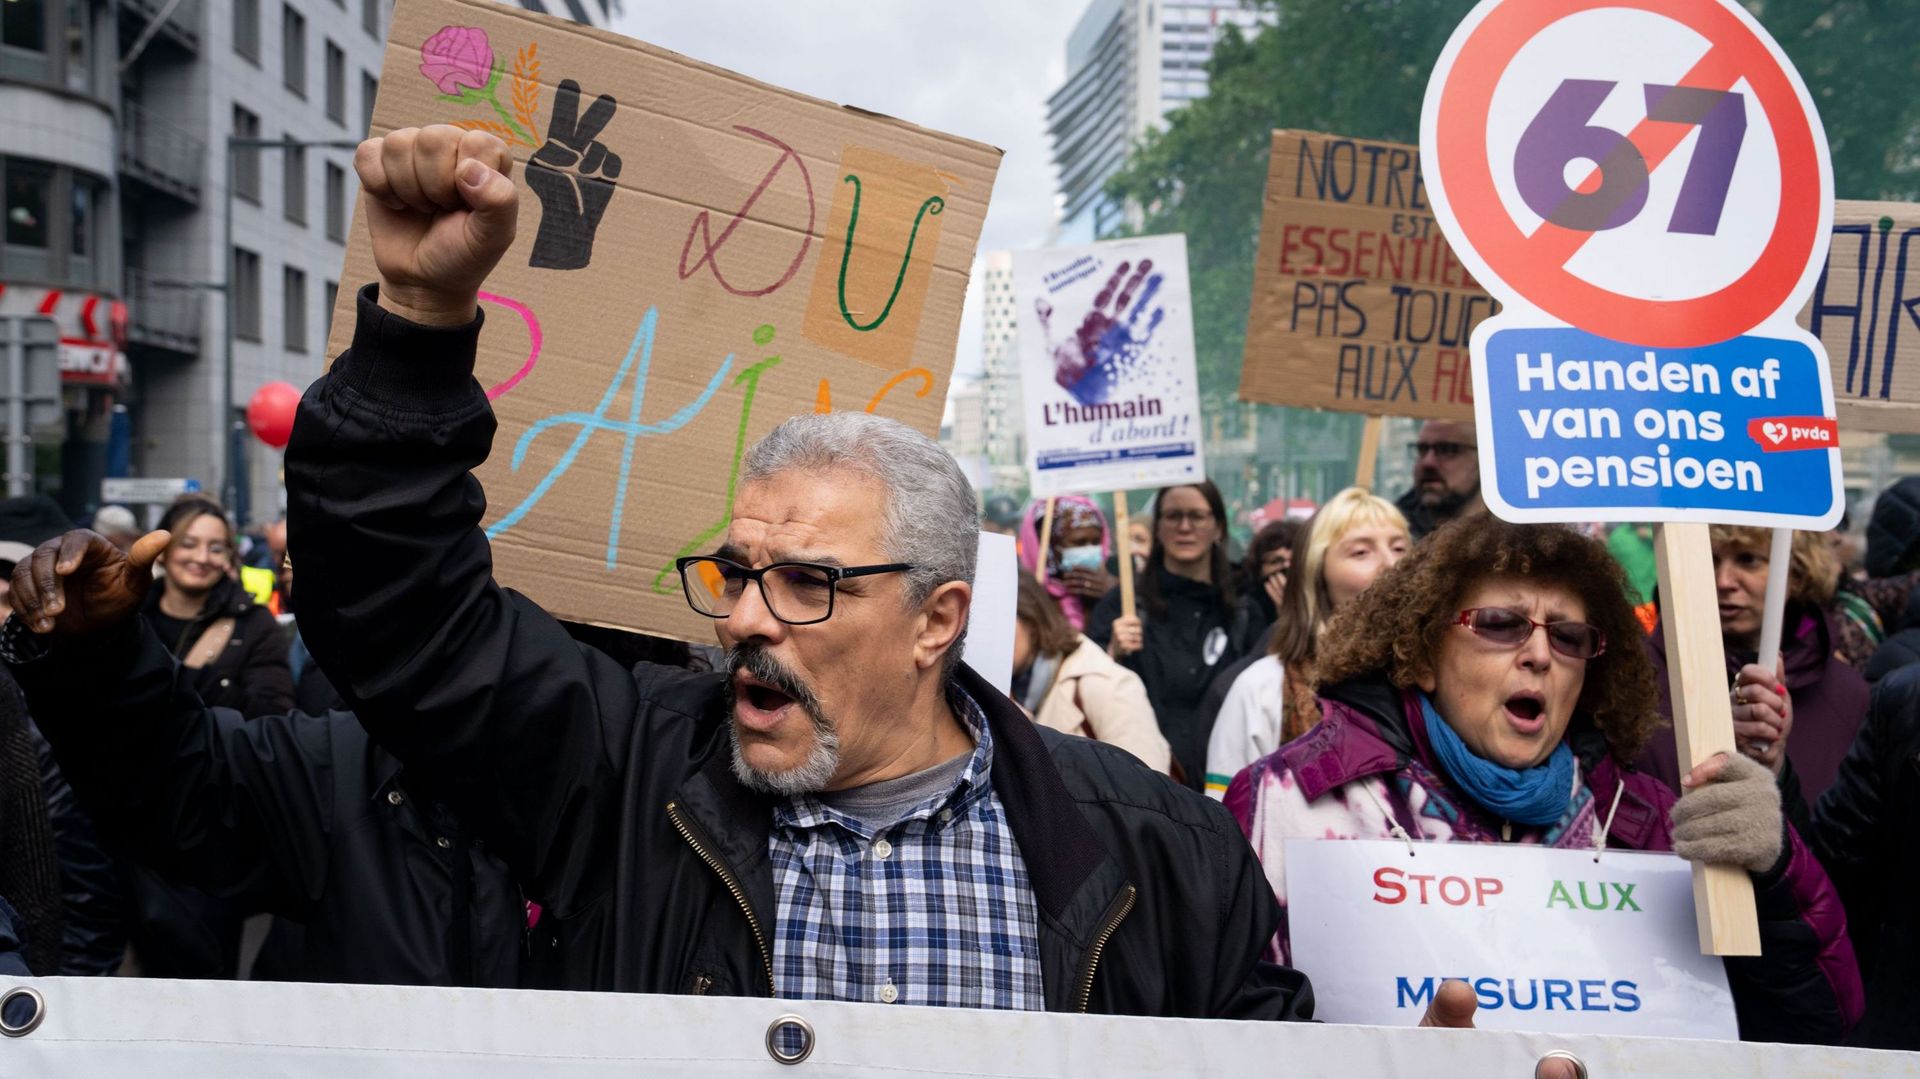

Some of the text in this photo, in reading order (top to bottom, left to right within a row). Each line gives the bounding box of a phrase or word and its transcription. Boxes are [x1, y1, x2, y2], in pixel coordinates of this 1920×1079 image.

[1296, 137, 1426, 211] NOTRE
[1513, 78, 1747, 236] 67
[678, 124, 945, 332] DU
[1391, 213, 1433, 241] EST
[1290, 280, 1496, 348] PAS TOUC
[1336, 343, 1419, 403] AUX
[1515, 351, 1781, 399] Handen af
[1043, 394, 1163, 426] L'humain
[1518, 407, 1725, 442] van ons
[1791, 426, 1830, 441] pvda
[1524, 443, 1764, 499] pensioen
[1546, 879, 1645, 912] AUX
[1396, 976, 1642, 1013] MSURES
